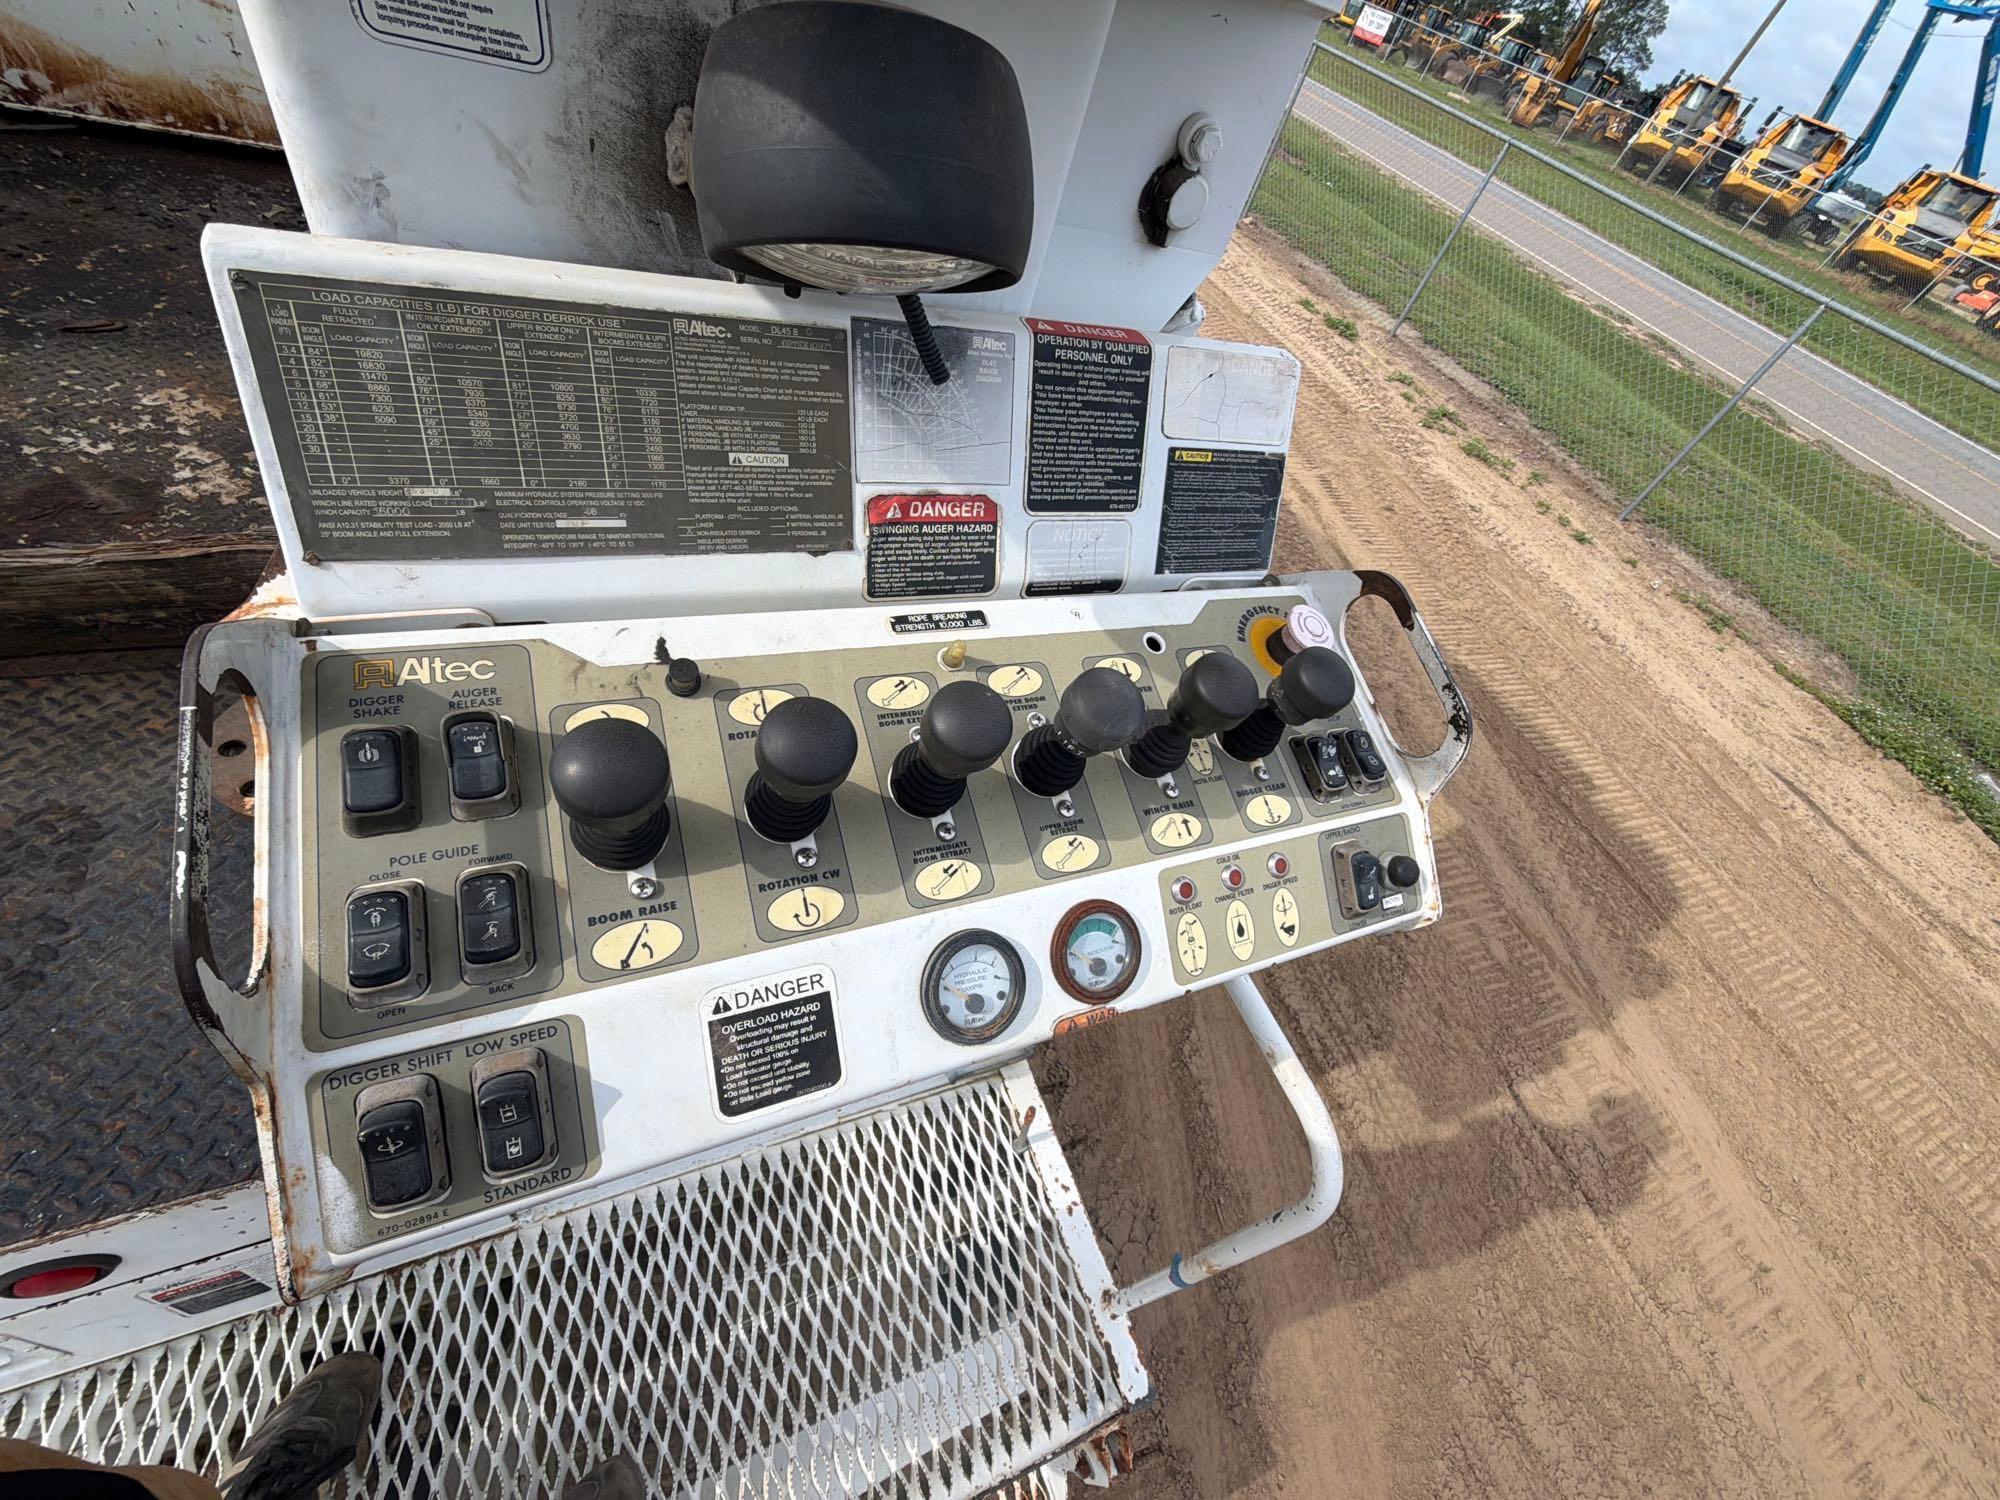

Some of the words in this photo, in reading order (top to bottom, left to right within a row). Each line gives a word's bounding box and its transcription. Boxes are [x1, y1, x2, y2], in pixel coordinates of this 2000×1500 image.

[439, 5, 469, 19] lubricant.
[471, 3, 494, 15] require
[375, 1, 388, 12] See
[389, 3, 431, 21] maintenance
[432, 13, 455, 26] manual
[467, 21, 488, 35] proper
[377, 12, 406, 27] torquing
[455, 29, 488, 45] retorquing
[489, 36, 502, 45] time
[312, 291, 350, 304] LOAD
[354, 296, 433, 311] CAPACITIES
[436, 302, 460, 315] (LB)
[464, 306, 490, 316] FOR
[493, 308, 540, 321] DIGGER
[543, 312, 595, 326] DERRICK
[598, 317, 621, 328] USE
[333, 307, 360, 316] FULLY
[322, 315, 374, 326] RETRACTED
[405, 313, 465, 326] INTERMEDIATE
[466, 319, 491, 327] BOOM
[416, 322, 438, 331] ONLY
[440, 324, 483, 334] EXTENDED
[507, 322, 533, 331] UPPER
[535, 325, 560, 333] BOOM
[561, 327, 581, 335] ONLY
[770, 326, 791, 336] DL45
[1063, 324, 1128, 338] DANGER
[330, 334, 353, 342] LOAD
[355, 336, 394, 345] CAPACITY
[524, 331, 566, 342] EXTENDED
[592, 329, 645, 341] INTERMEDIATE
[651, 335, 667, 343] UPR
[598, 337, 625, 346] BOOMS
[626, 340, 664, 349] EXTENDED
[983, 336, 1007, 350] Altec
[1037, 334, 1090, 348] OPERATION
[1091, 340, 1103, 350] BY
[1105, 341, 1150, 355] QUALIFIED
[355, 350, 383, 359] 19820
[1055, 349, 1108, 364] PERSONNEL
[1110, 355, 1133, 366] ONLY
[357, 361, 386, 371] 16830
[979, 367, 999, 375] RANGE
[360, 372, 387, 381] 11470
[457, 378, 483, 387] 10570
[550, 383, 574, 392] 10800
[463, 388, 484, 397] 7930
[372, 405, 394, 414] 6230
[374, 415, 397, 424] 5090
[469, 419, 490, 428] 4290
[471, 429, 491, 437] 3200
[473, 439, 493, 447] 2400
[746, 455, 785, 465] CAUTION
[1185, 452, 1209, 460] CAUTION
[909, 501, 984, 517] DANGER
[873, 525, 919, 535] SWINGING
[921, 525, 954, 533] AUGER
[956, 524, 993, 533] HAZARD
[908, 615, 928, 623] ROPE
[932, 612, 967, 621] BREAKING
[1237, 605, 1280, 642] EMERGENCY
[895, 622, 935, 632] STRENGTH
[939, 620, 964, 629] 10,000
[968, 619, 984, 627] LBS.
[397, 656, 496, 687] Altec
[452, 687, 498, 699] AUGER
[349, 694, 404, 709] DIGGER
[448, 697, 502, 711] RELEASE
[1012, 704, 1038, 712] EXTEND
[353, 706, 401, 719] SHAKE
[879, 719, 905, 728] BOOM
[727, 730, 759, 741] ROTA
[1208, 775, 1224, 784] FLOAT
[1236, 787, 1263, 797] DIGGER
[1265, 782, 1286, 792] CLEAN
[1143, 804, 1170, 816] WINCH
[1172, 800, 1195, 811] RAISE
[1040, 822, 1061, 832] UPPER
[1063, 818, 1084, 828] BOOM
[1050, 826, 1078, 836] RETRACT
[913, 840, 969, 857] INTERMEDIATE
[389, 851, 427, 868] POLE
[432, 844, 480, 861] GUIDE
[468, 853, 513, 866] FORWARD
[913, 853, 938, 864] BOOM
[940, 848, 973, 860] RETRACT
[369, 870, 402, 882] CLOSE
[758, 874, 818, 893] ROTATION
[822, 868, 841, 880] CW
[1263, 880, 1281, 891] DIGGER
[1282, 876, 1298, 886] SPEED
[1214, 892, 1237, 903] CHANGE
[1238, 888, 1254, 897] FILTER
[587, 910, 634, 927] BOOM
[638, 900, 677, 917] RAISE
[1169, 906, 1184, 916] ROTA
[1185, 901, 1202, 911] FLOAT
[488, 983, 514, 995] BACK
[734, 973, 825, 1010] DANGER
[377, 1007, 406, 1020] OPEN
[722, 1012, 779, 1035] OVERLOAD
[780, 1002, 821, 1020] HAZARD
[730, 1026, 773, 1043] Overloading
[774, 1021, 789, 1031] may
[790, 1017, 809, 1027] result
[465, 1037, 504, 1059] LOW
[510, 1025, 558, 1048] SPEED
[736, 1036, 770, 1051] structural
[771, 1029, 799, 1043] damage
[800, 1024, 813, 1034] and
[721, 1051, 750, 1066] DEATH
[751, 1047, 763, 1057] OR
[765, 1038, 800, 1053] SERIOUS
[801, 1030, 828, 1044] INJURY
[747, 1055, 771, 1068] exceed
[772, 1051, 790, 1060] 100%
[329, 1062, 401, 1091] DIGGER
[407, 1050, 453, 1071] SHIFT
[726, 1071, 743, 1081] Load
[744, 1064, 771, 1076] Indicator
[775, 1074, 795, 1085] yellow
[795, 1070, 811, 1078] zone
[756, 1088, 772, 1099] Load
[484, 1167, 572, 1204] STANDARD
[377, 1212, 440, 1236] 670-02894
